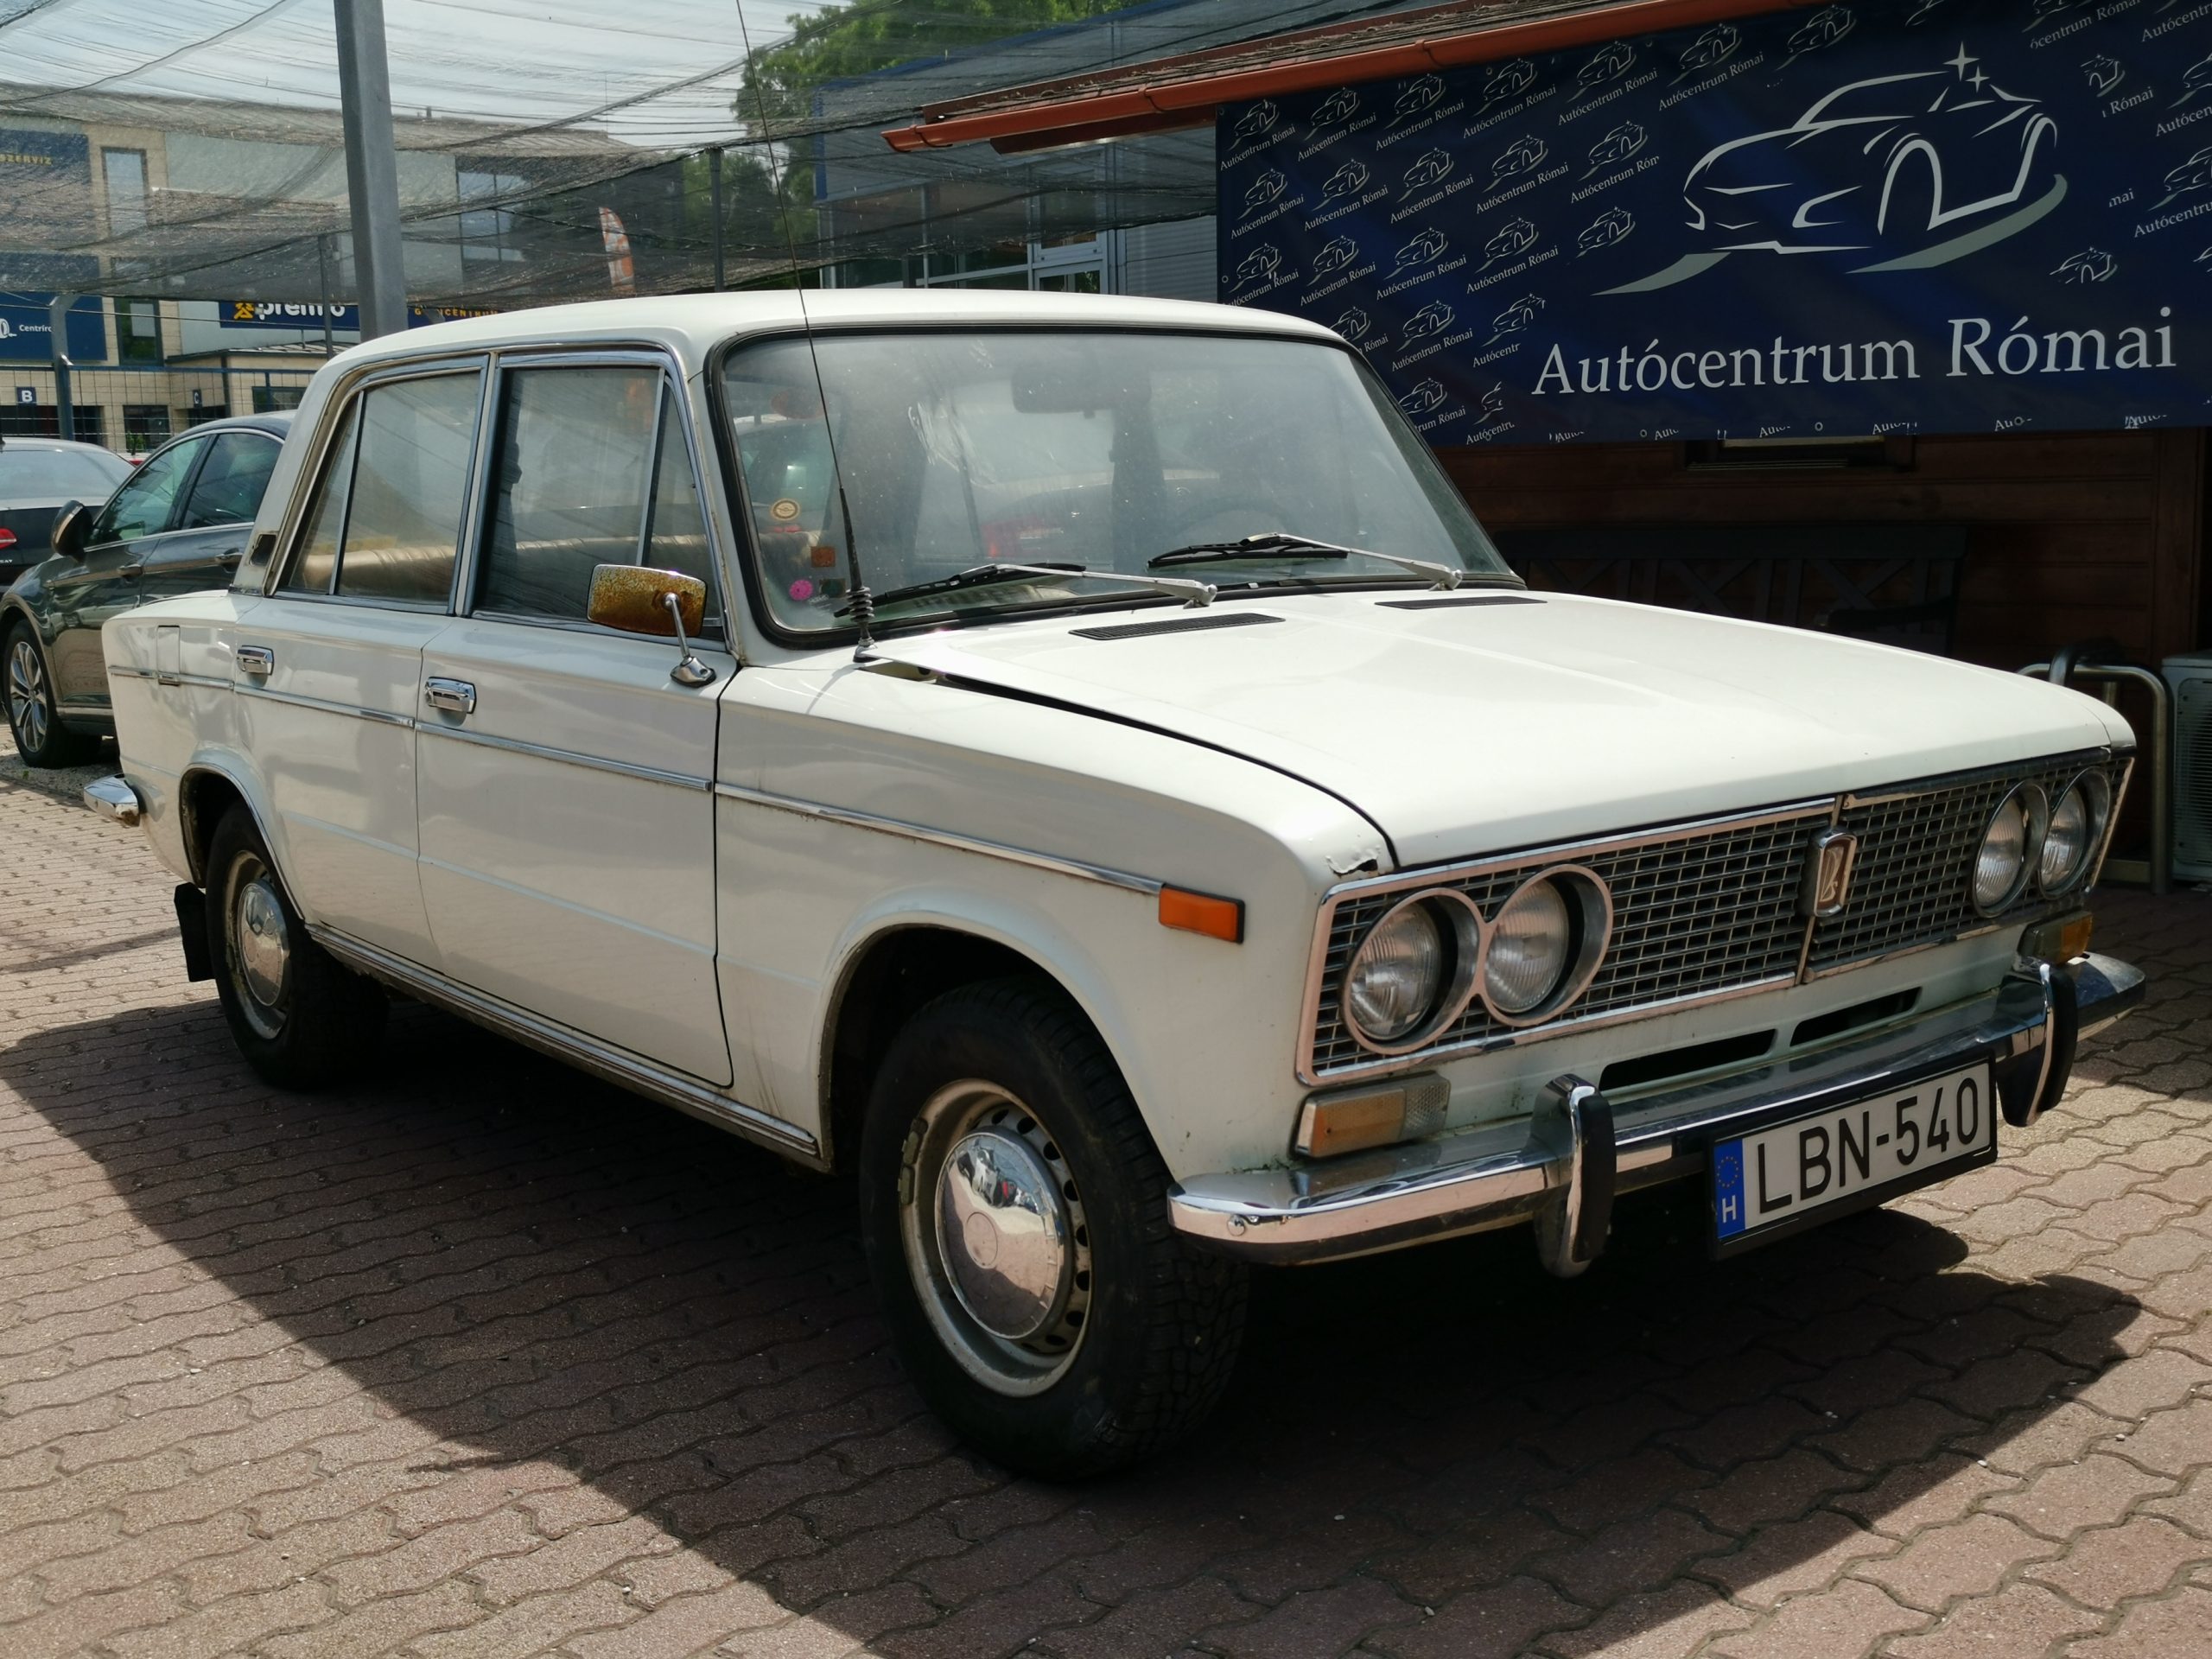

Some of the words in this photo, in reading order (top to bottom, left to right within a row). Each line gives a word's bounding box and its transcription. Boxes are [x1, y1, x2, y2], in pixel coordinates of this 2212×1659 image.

[1558, 87, 1623, 126] Autócentrum
[1624, 67, 1658, 92] Római
[1658, 73, 1728, 112] Autócentrum
[1729, 51, 1764, 75] Római
[2109, 86, 2154, 114] Római
[1375, 118, 1433, 151] Autócentrum
[1433, 99, 1465, 122] Római
[1462, 102, 1524, 139] Autócentrum
[1525, 84, 1556, 107] Római
[1220, 141, 1271, 171] Autócentrum
[1271, 124, 1296, 144] Római
[1297, 129, 1347, 162] Autócentrum
[1348, 111, 1377, 134] Római
[1304, 200, 1361, 232] Autócentrum
[1362, 184, 1389, 207] Római
[1389, 191, 1444, 224] Autócentrum
[1444, 173, 1475, 197] Római
[1475, 175, 1536, 214] Autócentrum
[1537, 162, 1569, 186] Római
[1570, 168, 1635, 204] Autócentrum
[1230, 208, 1279, 239] Autócentrum
[1279, 194, 1305, 215] Római
[1300, 276, 1349, 307] Autócentrum
[1349, 261, 1376, 283] Római
[1376, 270, 1436, 301] Autócentrum
[1437, 254, 1467, 275] Római
[1465, 264, 1527, 295] Autócentrum
[1528, 245, 1559, 266] Római
[258, 302, 346, 321] premo
[1390, 343, 1442, 372] Autócentrum
[1443, 327, 1474, 348] Római
[1530, 335, 1921, 395] Autócentrum
[1945, 307, 2177, 378] Római
[21, 390, 33, 403] B
[1438, 405, 1466, 425] Római
[1758, 1077, 1979, 1215] LBN-540
[1721, 1194, 1738, 1224] H
